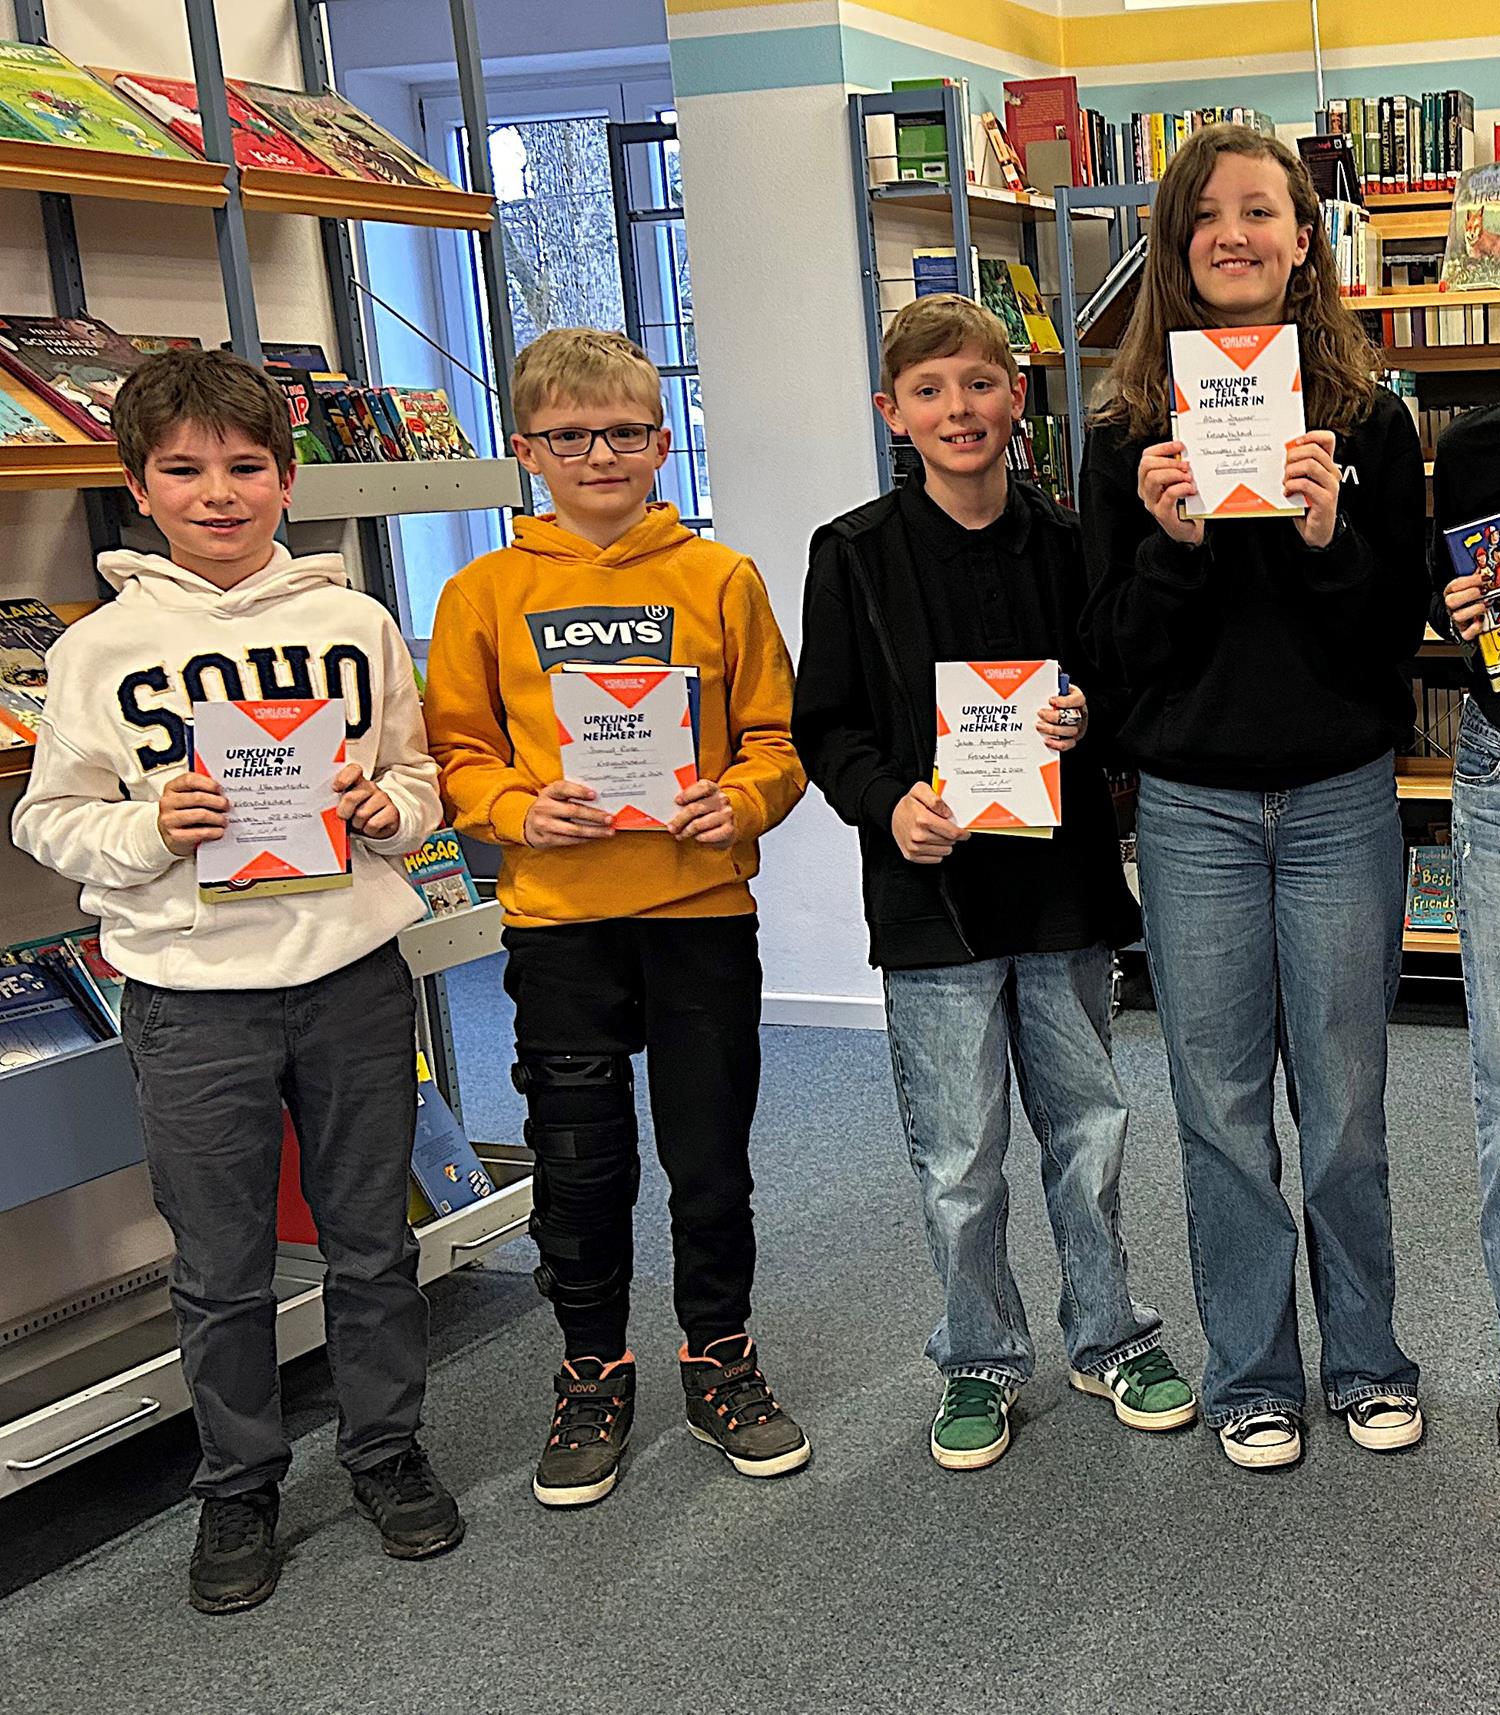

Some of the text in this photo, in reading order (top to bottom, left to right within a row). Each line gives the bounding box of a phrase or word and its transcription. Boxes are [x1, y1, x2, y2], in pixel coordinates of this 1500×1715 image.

[1200, 377, 1258, 389] URKUNDE
[1215, 387, 1238, 398] TEIL
[117, 644, 372, 772] SOHO
[962, 706, 1017, 715] URKUNDE
[584, 714, 645, 724] URKUNDE
[976, 715, 996, 723] TEIL
[599, 724, 622, 732] TEIL
[226, 747, 295, 759] URKUNDE
[243, 758, 270, 767] TEIL
[403, 841, 459, 874] HAGAR
[1422, 869, 1452, 887] Best
[1413, 894, 1455, 913] Friends
